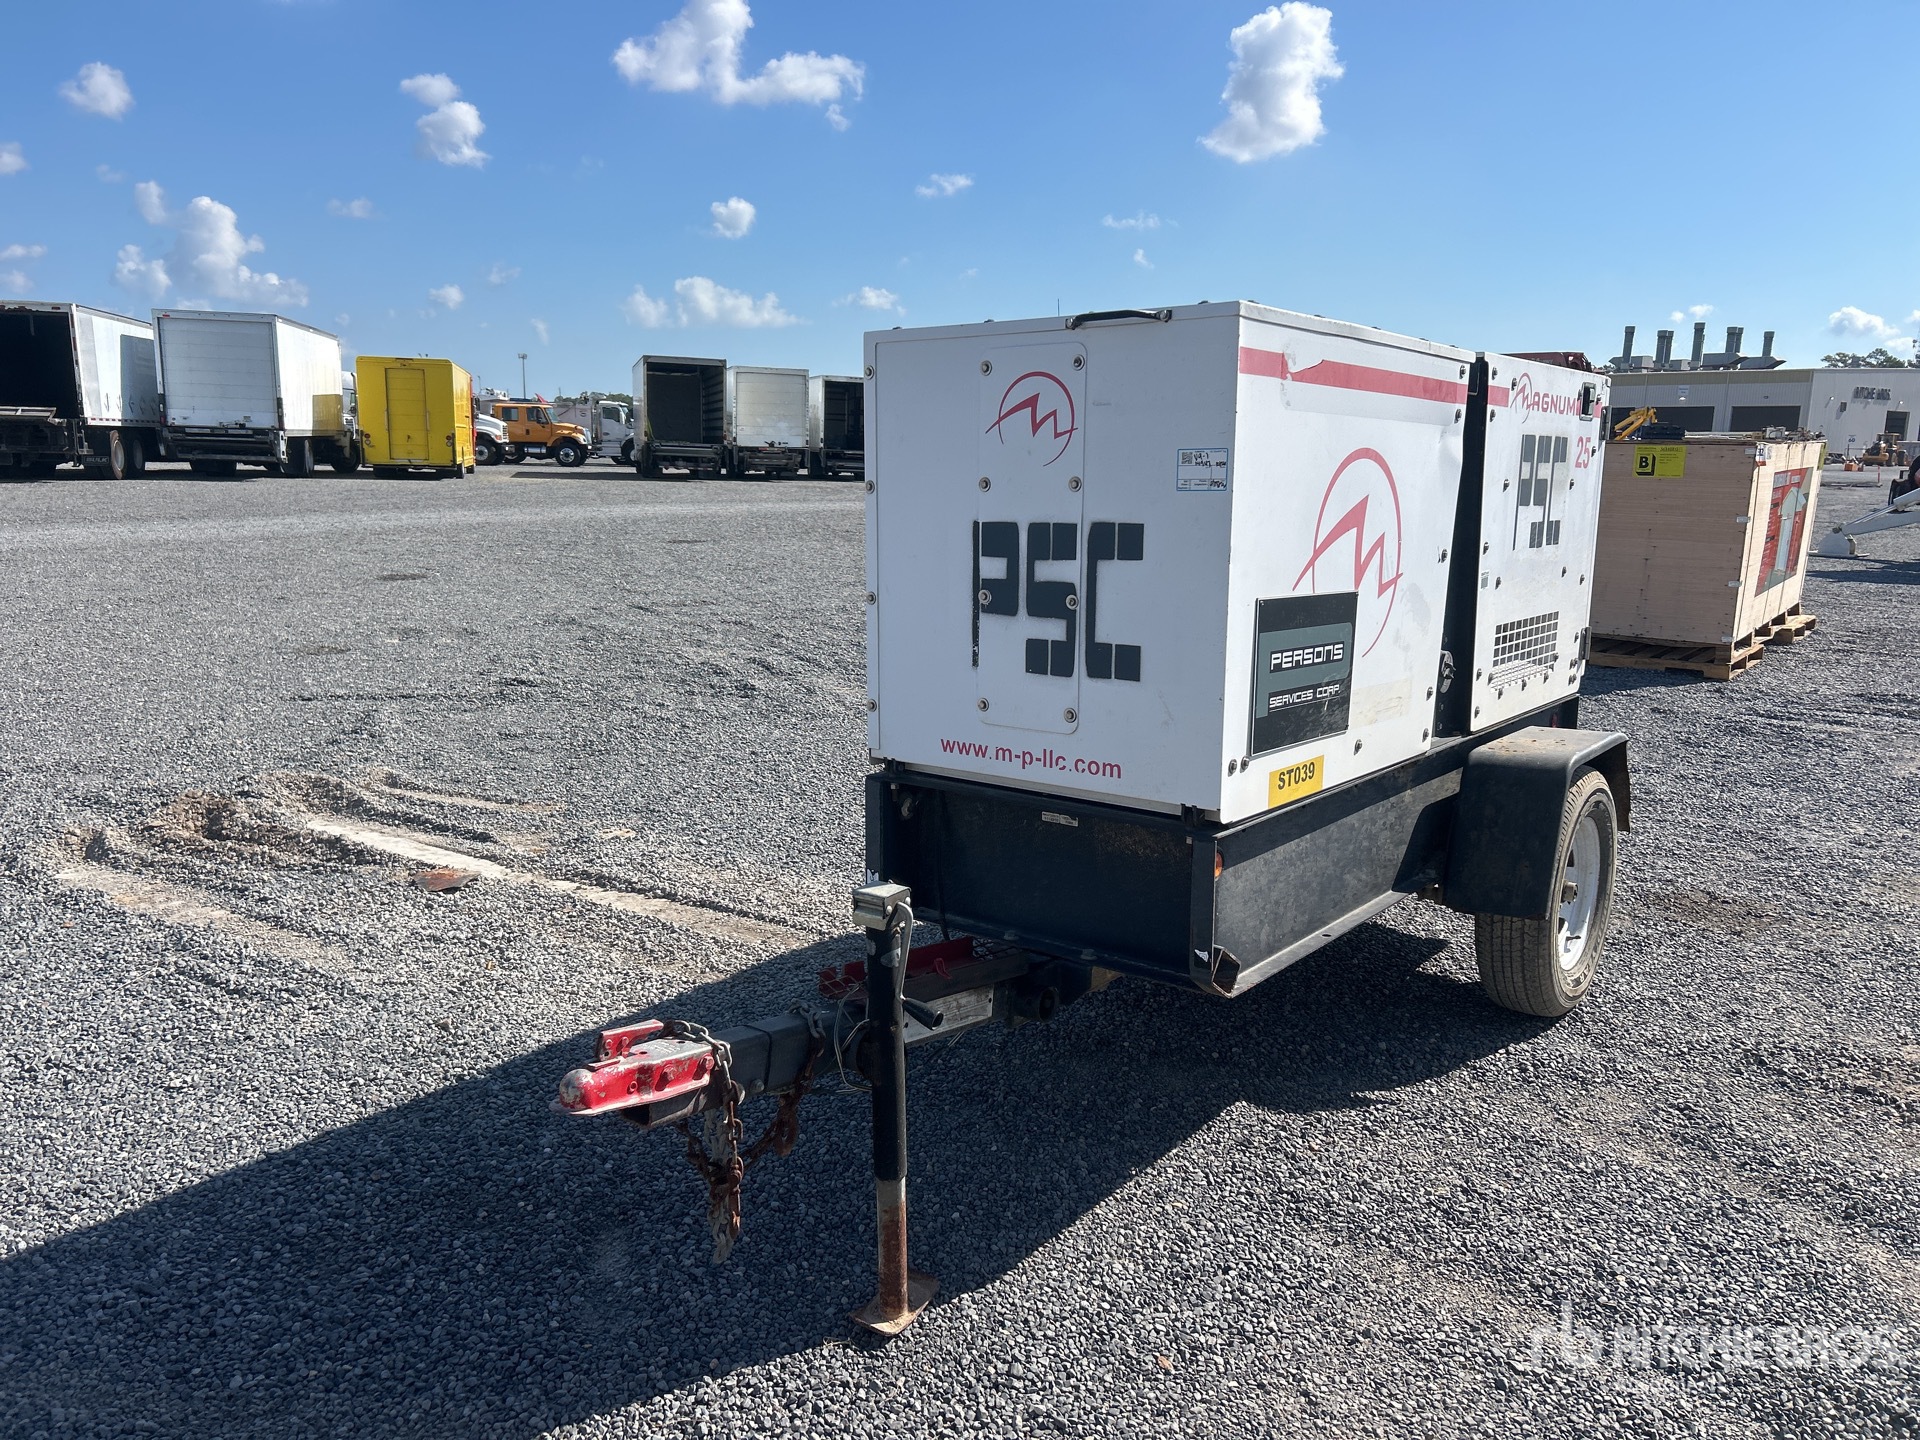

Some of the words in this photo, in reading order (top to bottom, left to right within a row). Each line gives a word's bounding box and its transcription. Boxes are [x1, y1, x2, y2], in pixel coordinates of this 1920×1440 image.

[1575, 436, 1592, 469] 25
[1638, 455, 1650, 469] B
[1512, 434, 1569, 551] PSC
[972, 520, 1145, 682] PSC
[1271, 643, 1344, 671] PERSONS
[1269, 689, 1314, 708] SERVICES
[1316, 684, 1341, 698] CORP.
[941, 738, 1122, 779] www.m-p-llc.com
[1277, 761, 1316, 790] ST039
